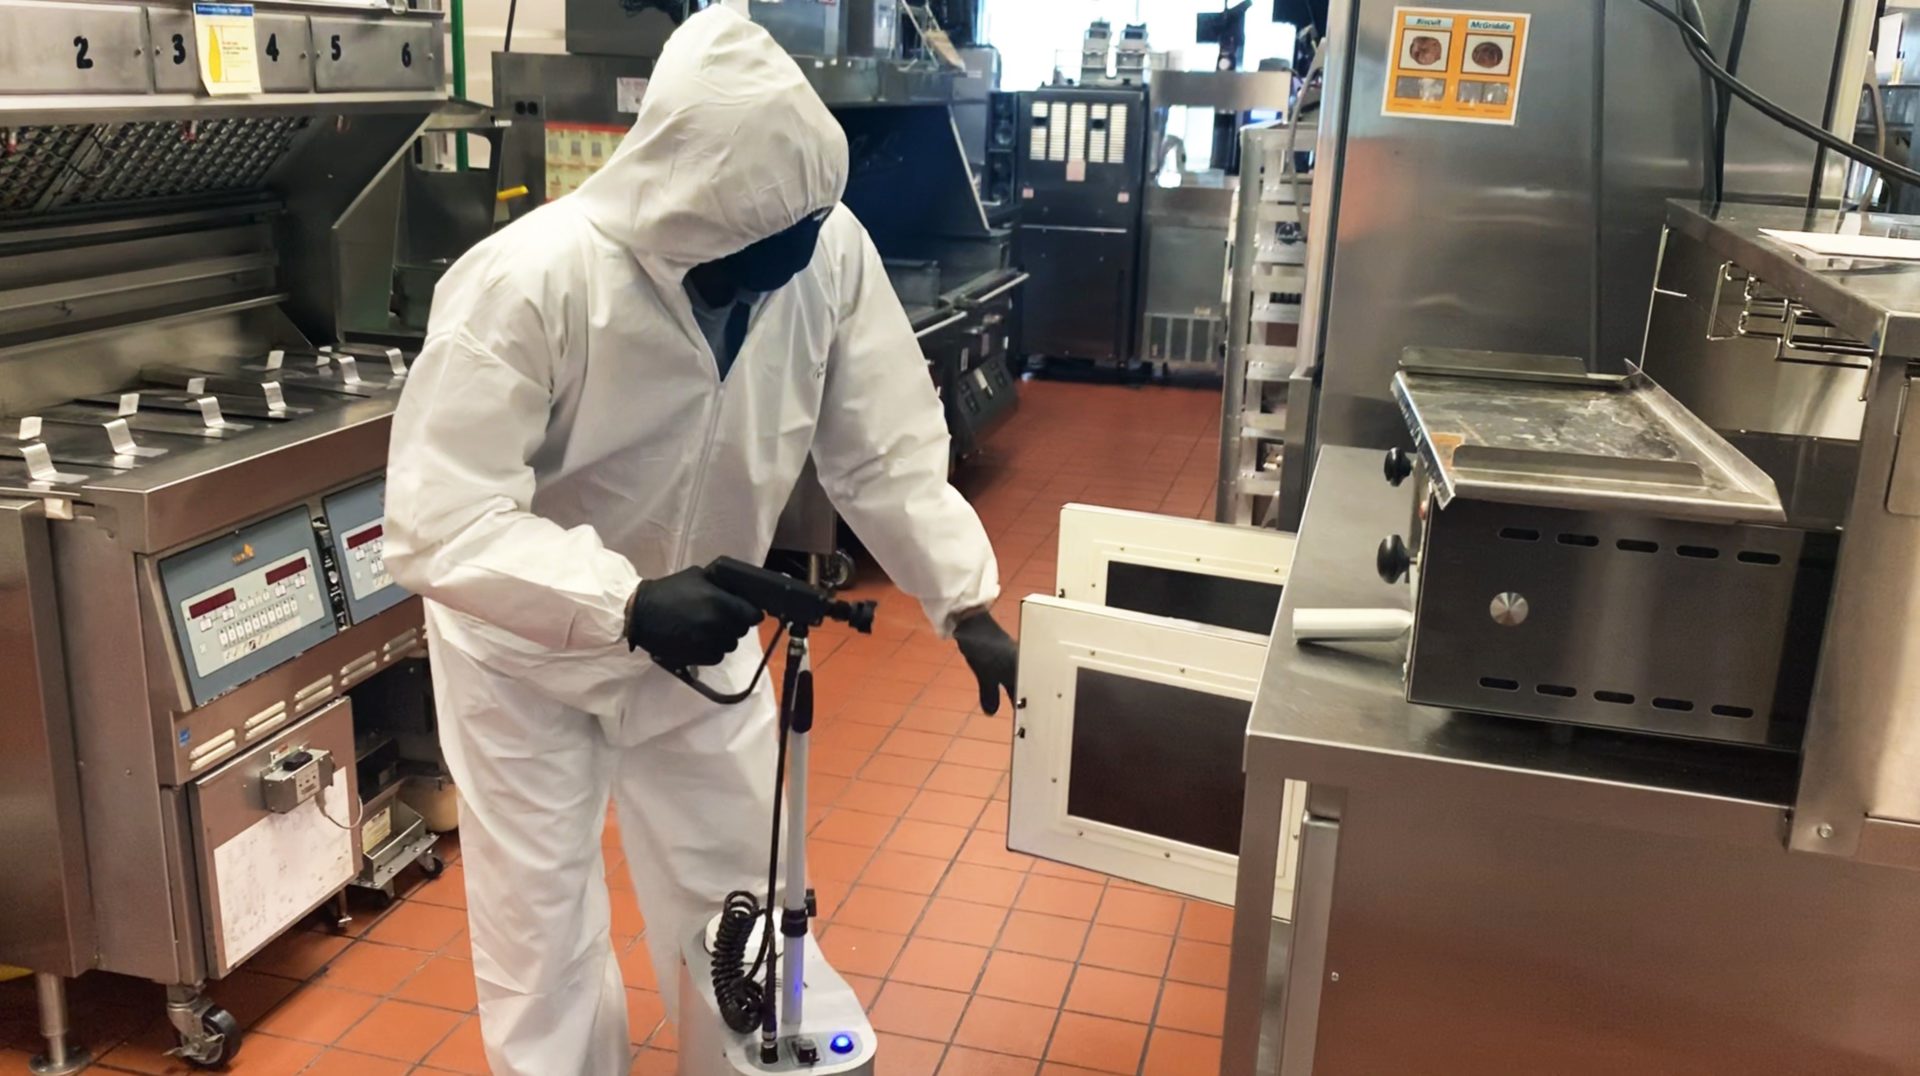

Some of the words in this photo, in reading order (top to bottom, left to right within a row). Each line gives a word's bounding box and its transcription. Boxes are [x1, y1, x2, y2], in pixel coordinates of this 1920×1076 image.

[73, 35, 94, 70] 2
[171, 33, 187, 65] 3
[265, 33, 280, 62] 4
[330, 34, 342, 62] 5
[401, 41, 413, 68] 6
